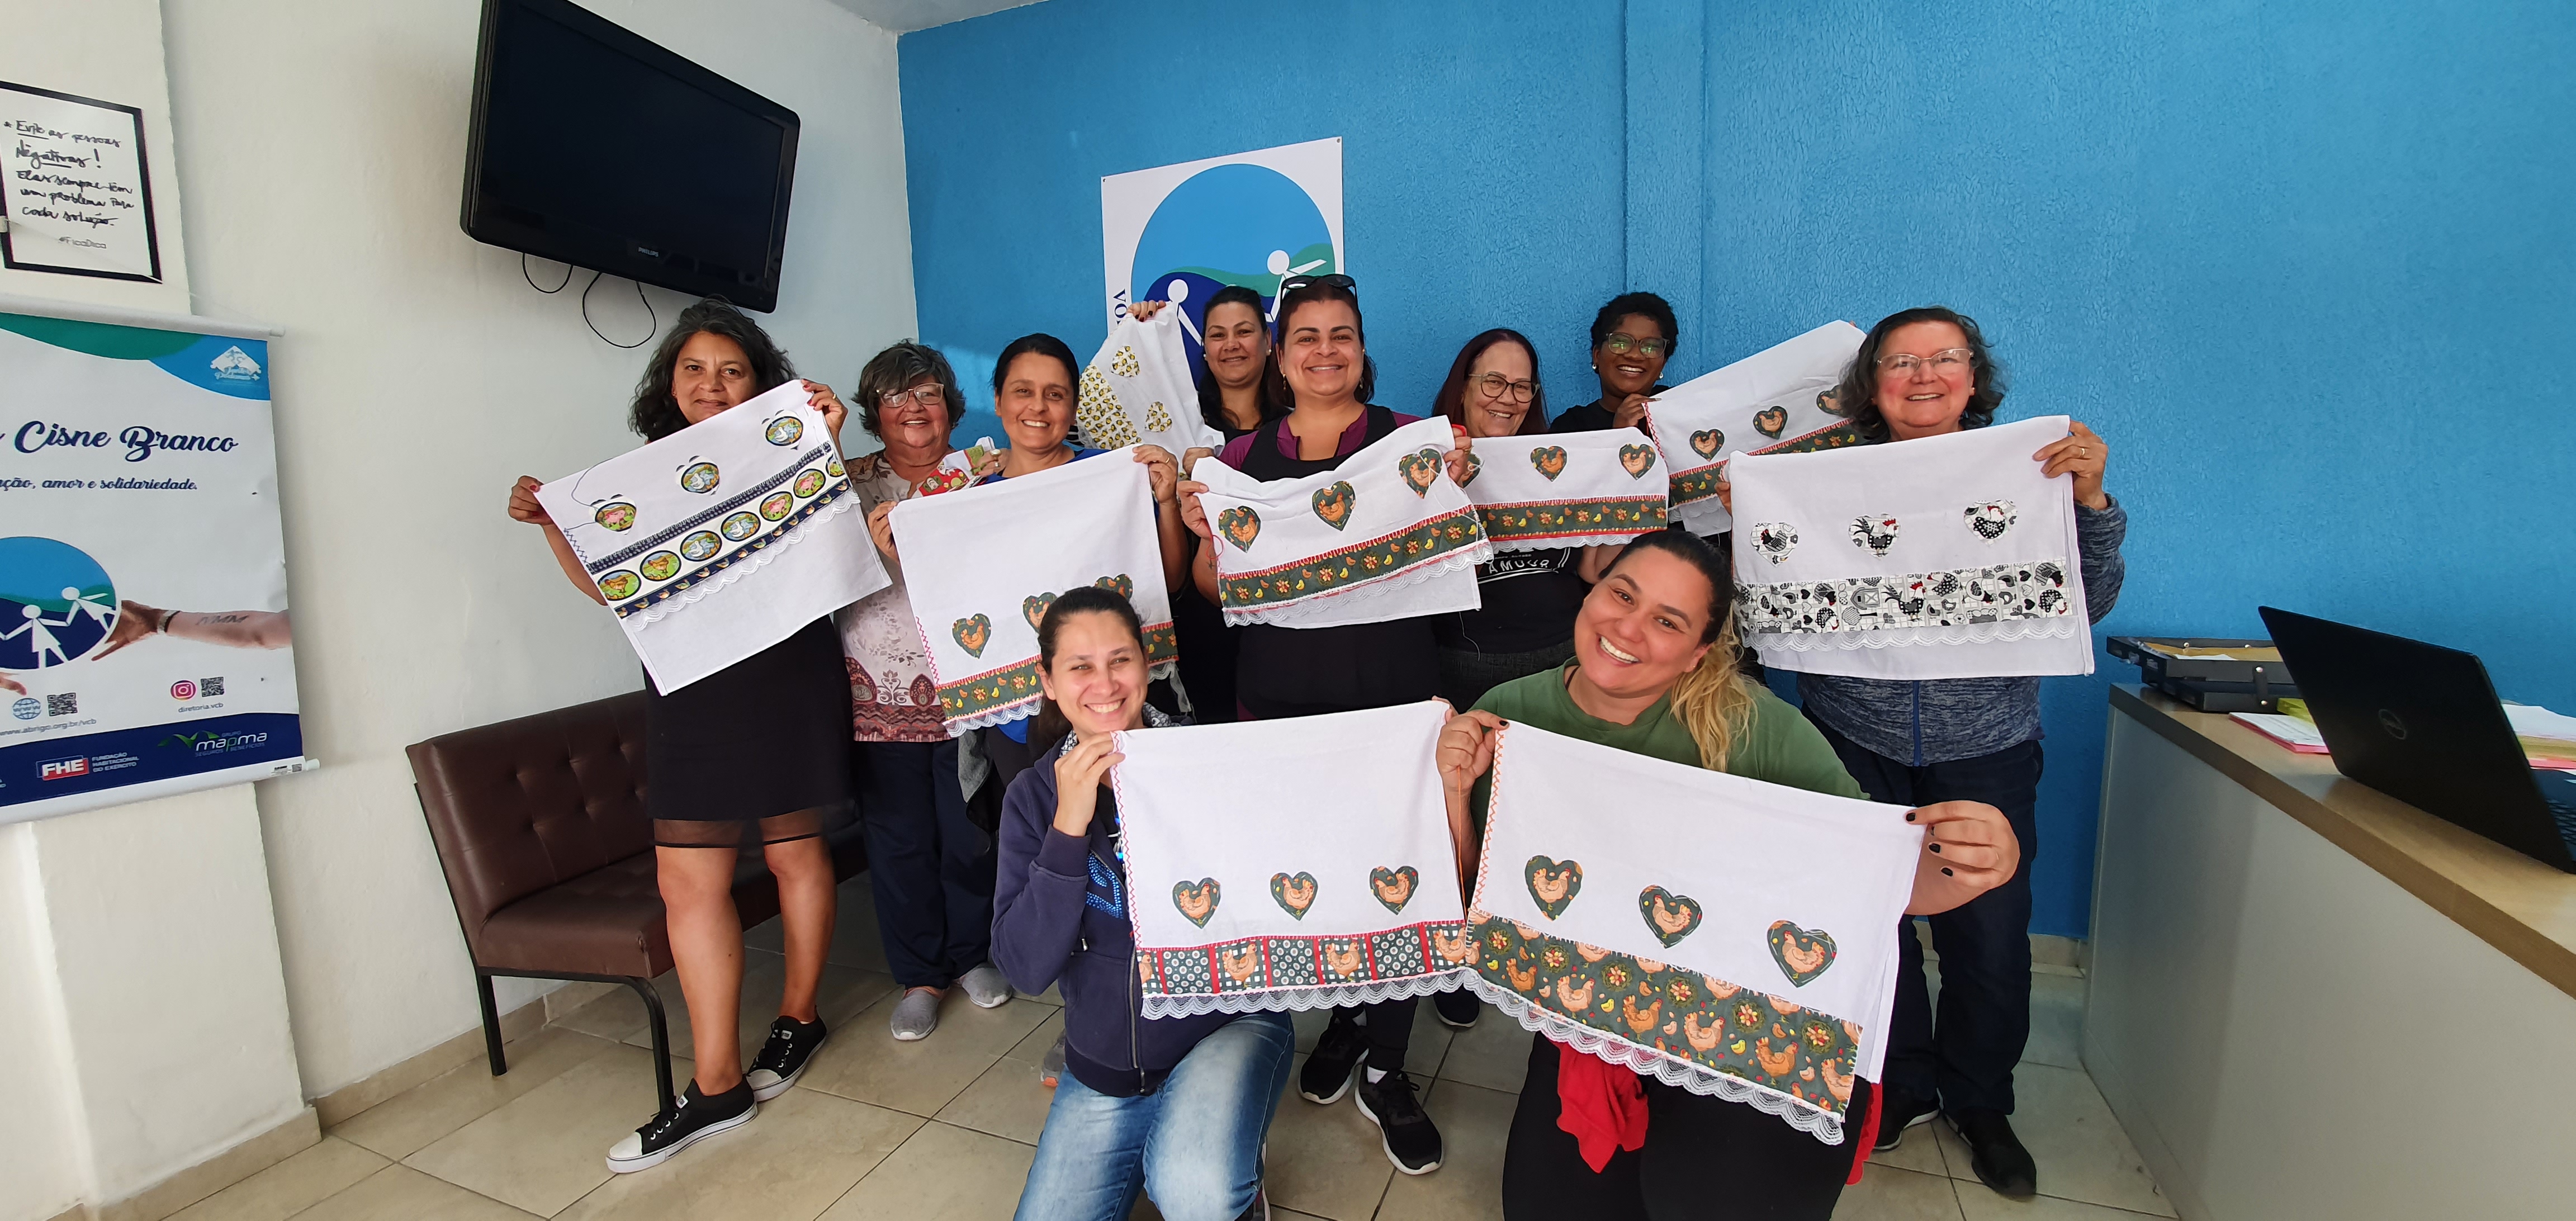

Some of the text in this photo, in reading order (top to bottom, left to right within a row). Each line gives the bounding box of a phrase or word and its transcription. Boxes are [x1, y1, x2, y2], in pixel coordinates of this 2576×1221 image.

[15, 420, 239, 462] Cisne Branco
[41, 479, 85, 489] amor
[87, 480, 97, 489] e
[100, 476, 197, 490] solidariedade.
[178, 702, 224, 713] diretoria.vcb
[196, 732, 267, 752] mapma
[42, 759, 84, 777] FHE
